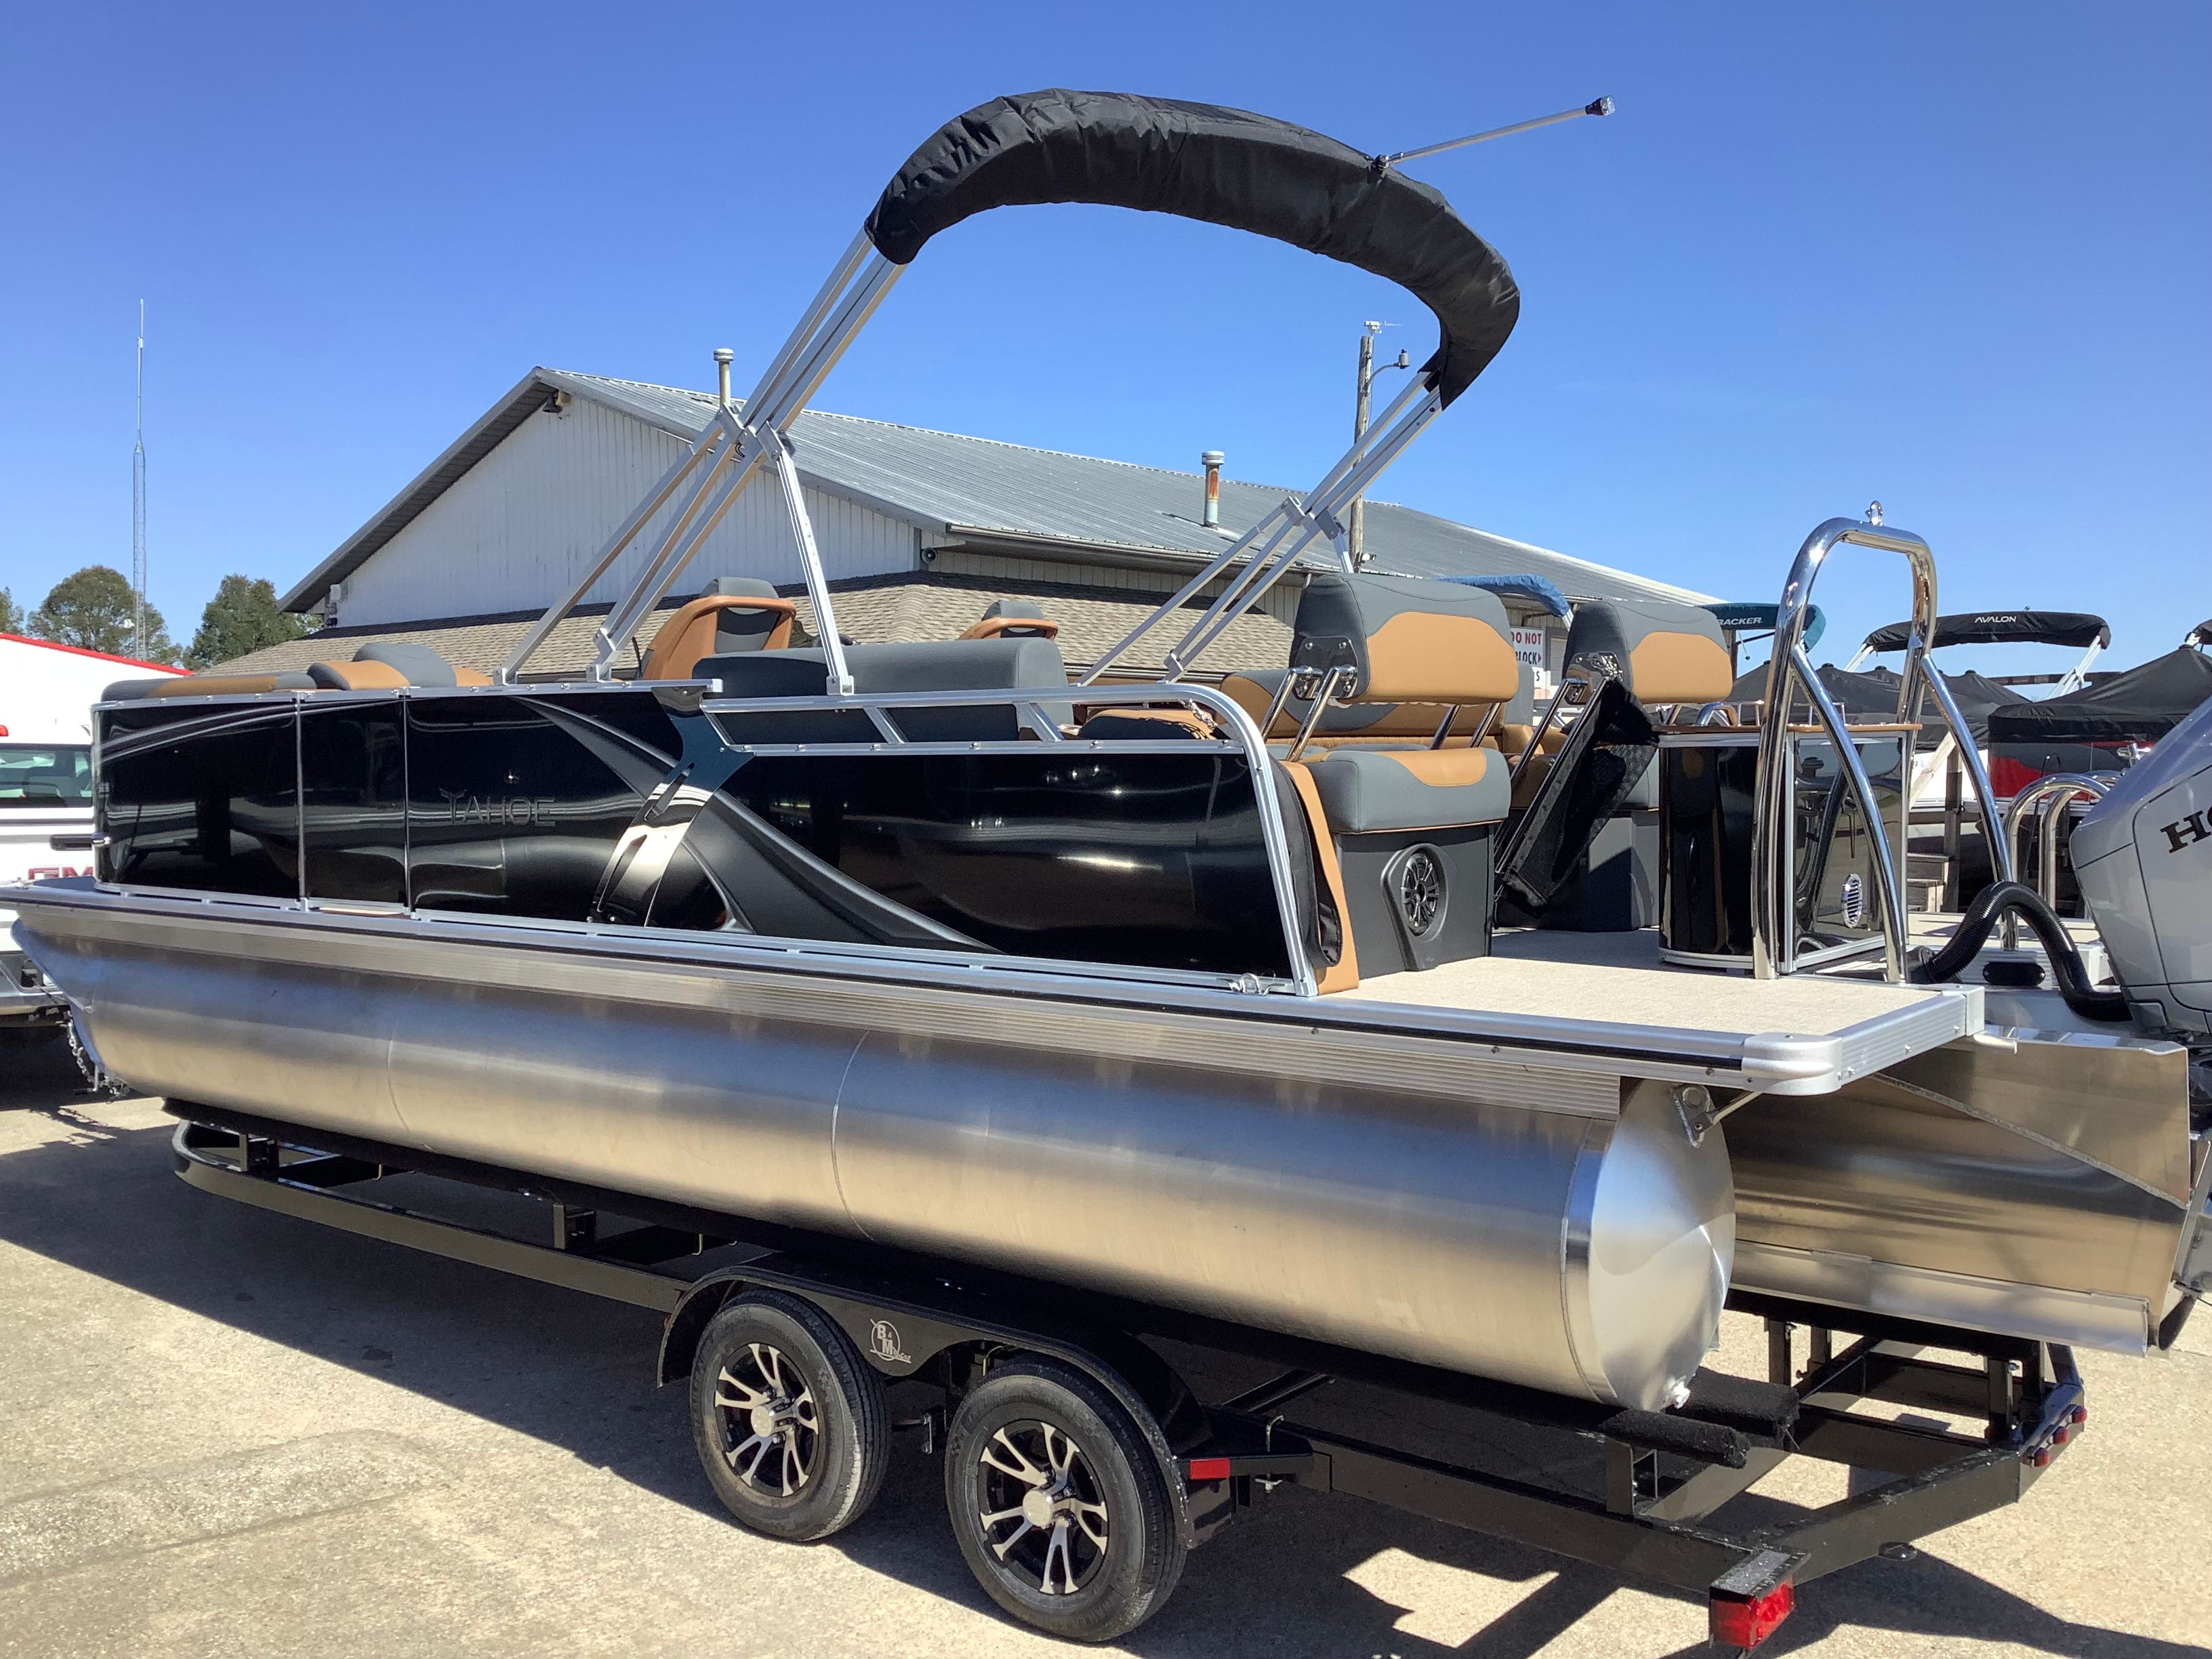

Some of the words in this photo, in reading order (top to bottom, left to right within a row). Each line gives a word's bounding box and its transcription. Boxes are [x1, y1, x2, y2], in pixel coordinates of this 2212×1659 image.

[1525, 632, 1542, 644] NOT
[439, 788, 556, 827] TAHOE
[2160, 806, 2212, 853] H
[28, 866, 94, 880] GM
